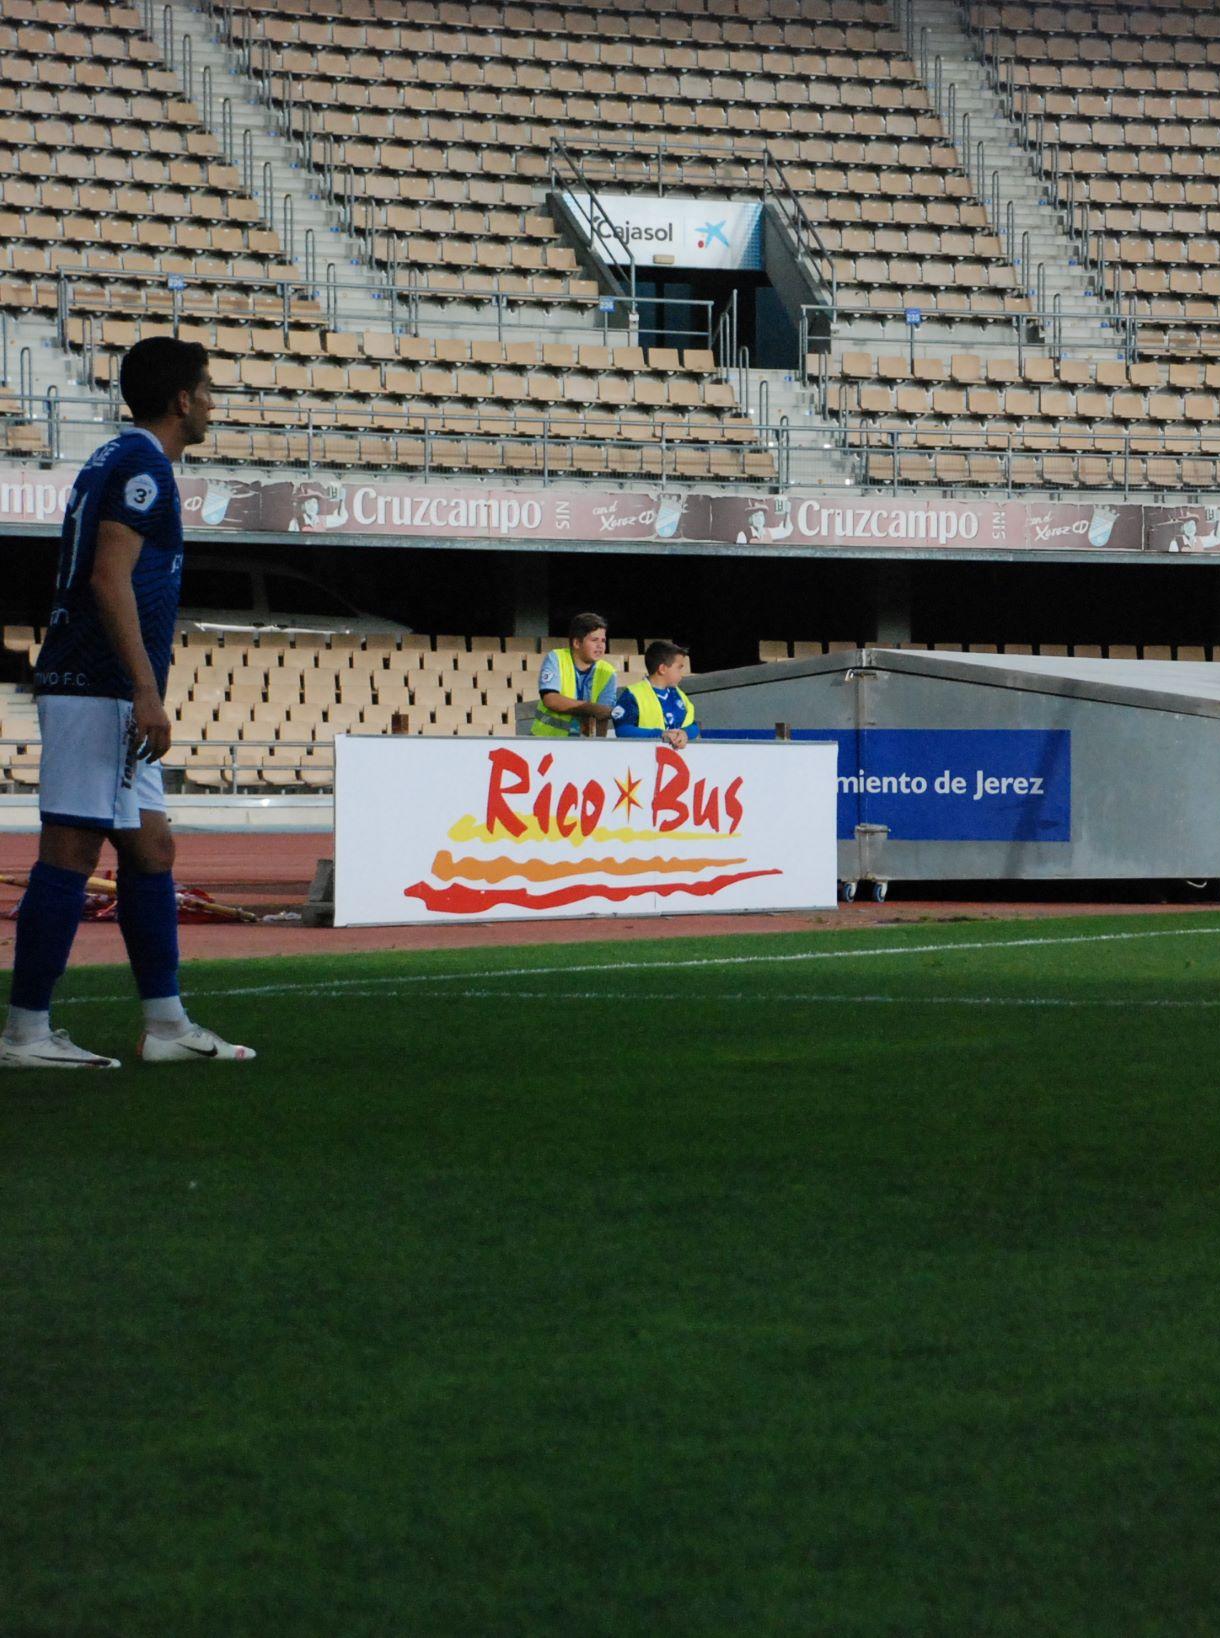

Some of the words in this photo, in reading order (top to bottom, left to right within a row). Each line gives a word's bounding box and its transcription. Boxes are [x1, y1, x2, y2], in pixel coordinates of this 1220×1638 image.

[596, 222, 673, 244] Cajasol
[353, 487, 543, 535] Cruzcampo
[556, 501, 571, 530] SIN
[600, 514, 638, 532] Xerez
[638, 510, 656, 524] CD
[798, 500, 980, 544] Cruzcampo
[1034, 524, 1073, 542] Xerez
[1072, 519, 1089, 534] CD
[651, 746, 744, 836] Bus
[837, 769, 928, 795] miento
[934, 770, 967, 795] de
[973, 770, 1045, 801] Jerez
